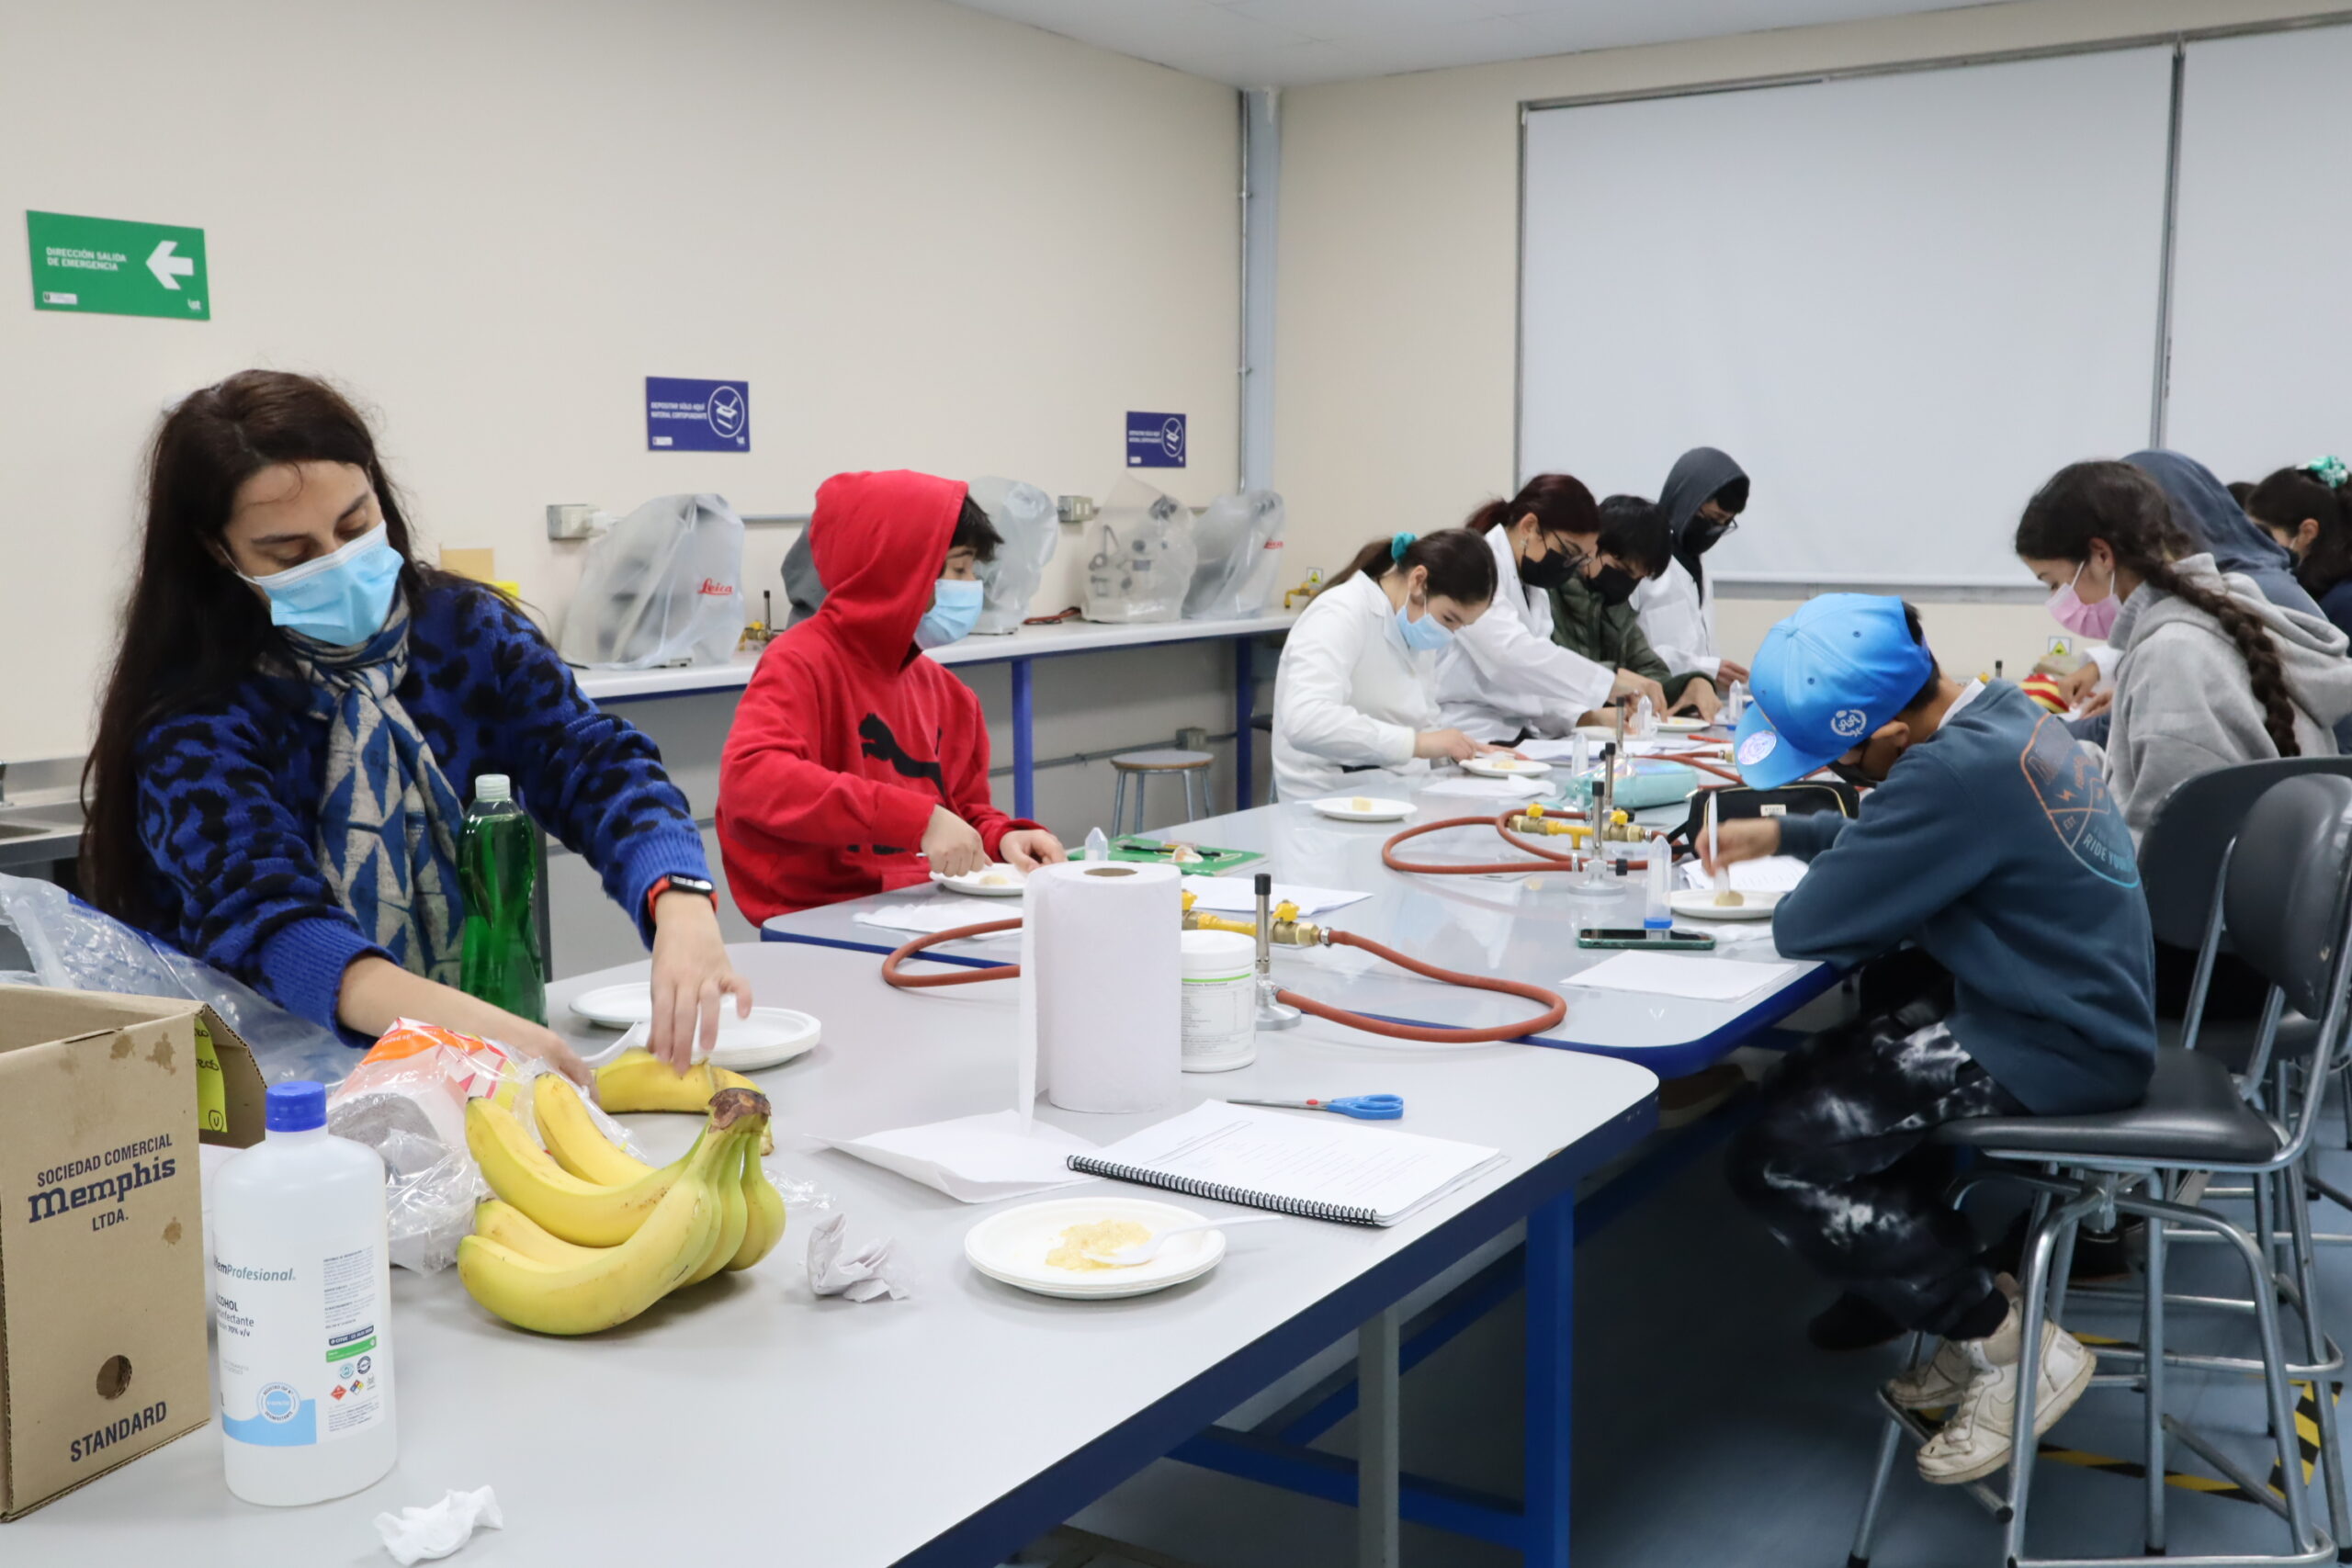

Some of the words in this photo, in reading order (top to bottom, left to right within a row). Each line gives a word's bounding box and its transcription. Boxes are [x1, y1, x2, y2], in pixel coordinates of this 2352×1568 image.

[46, 246, 95, 259] DIRECCIÓN
[96, 251, 127, 262] SALIDA
[47, 257, 60, 266] DE
[61, 258, 119, 271] EMERGENCIA
[697, 578, 734, 595] Leica
[2083, 833, 2106, 862] RIDE
[37, 1155, 101, 1188] SOCIEDAD
[104, 1133, 173, 1167] COMERCIAL
[92, 1208, 129, 1232] LTDA.
[70, 1401, 167, 1462] STANDARD
